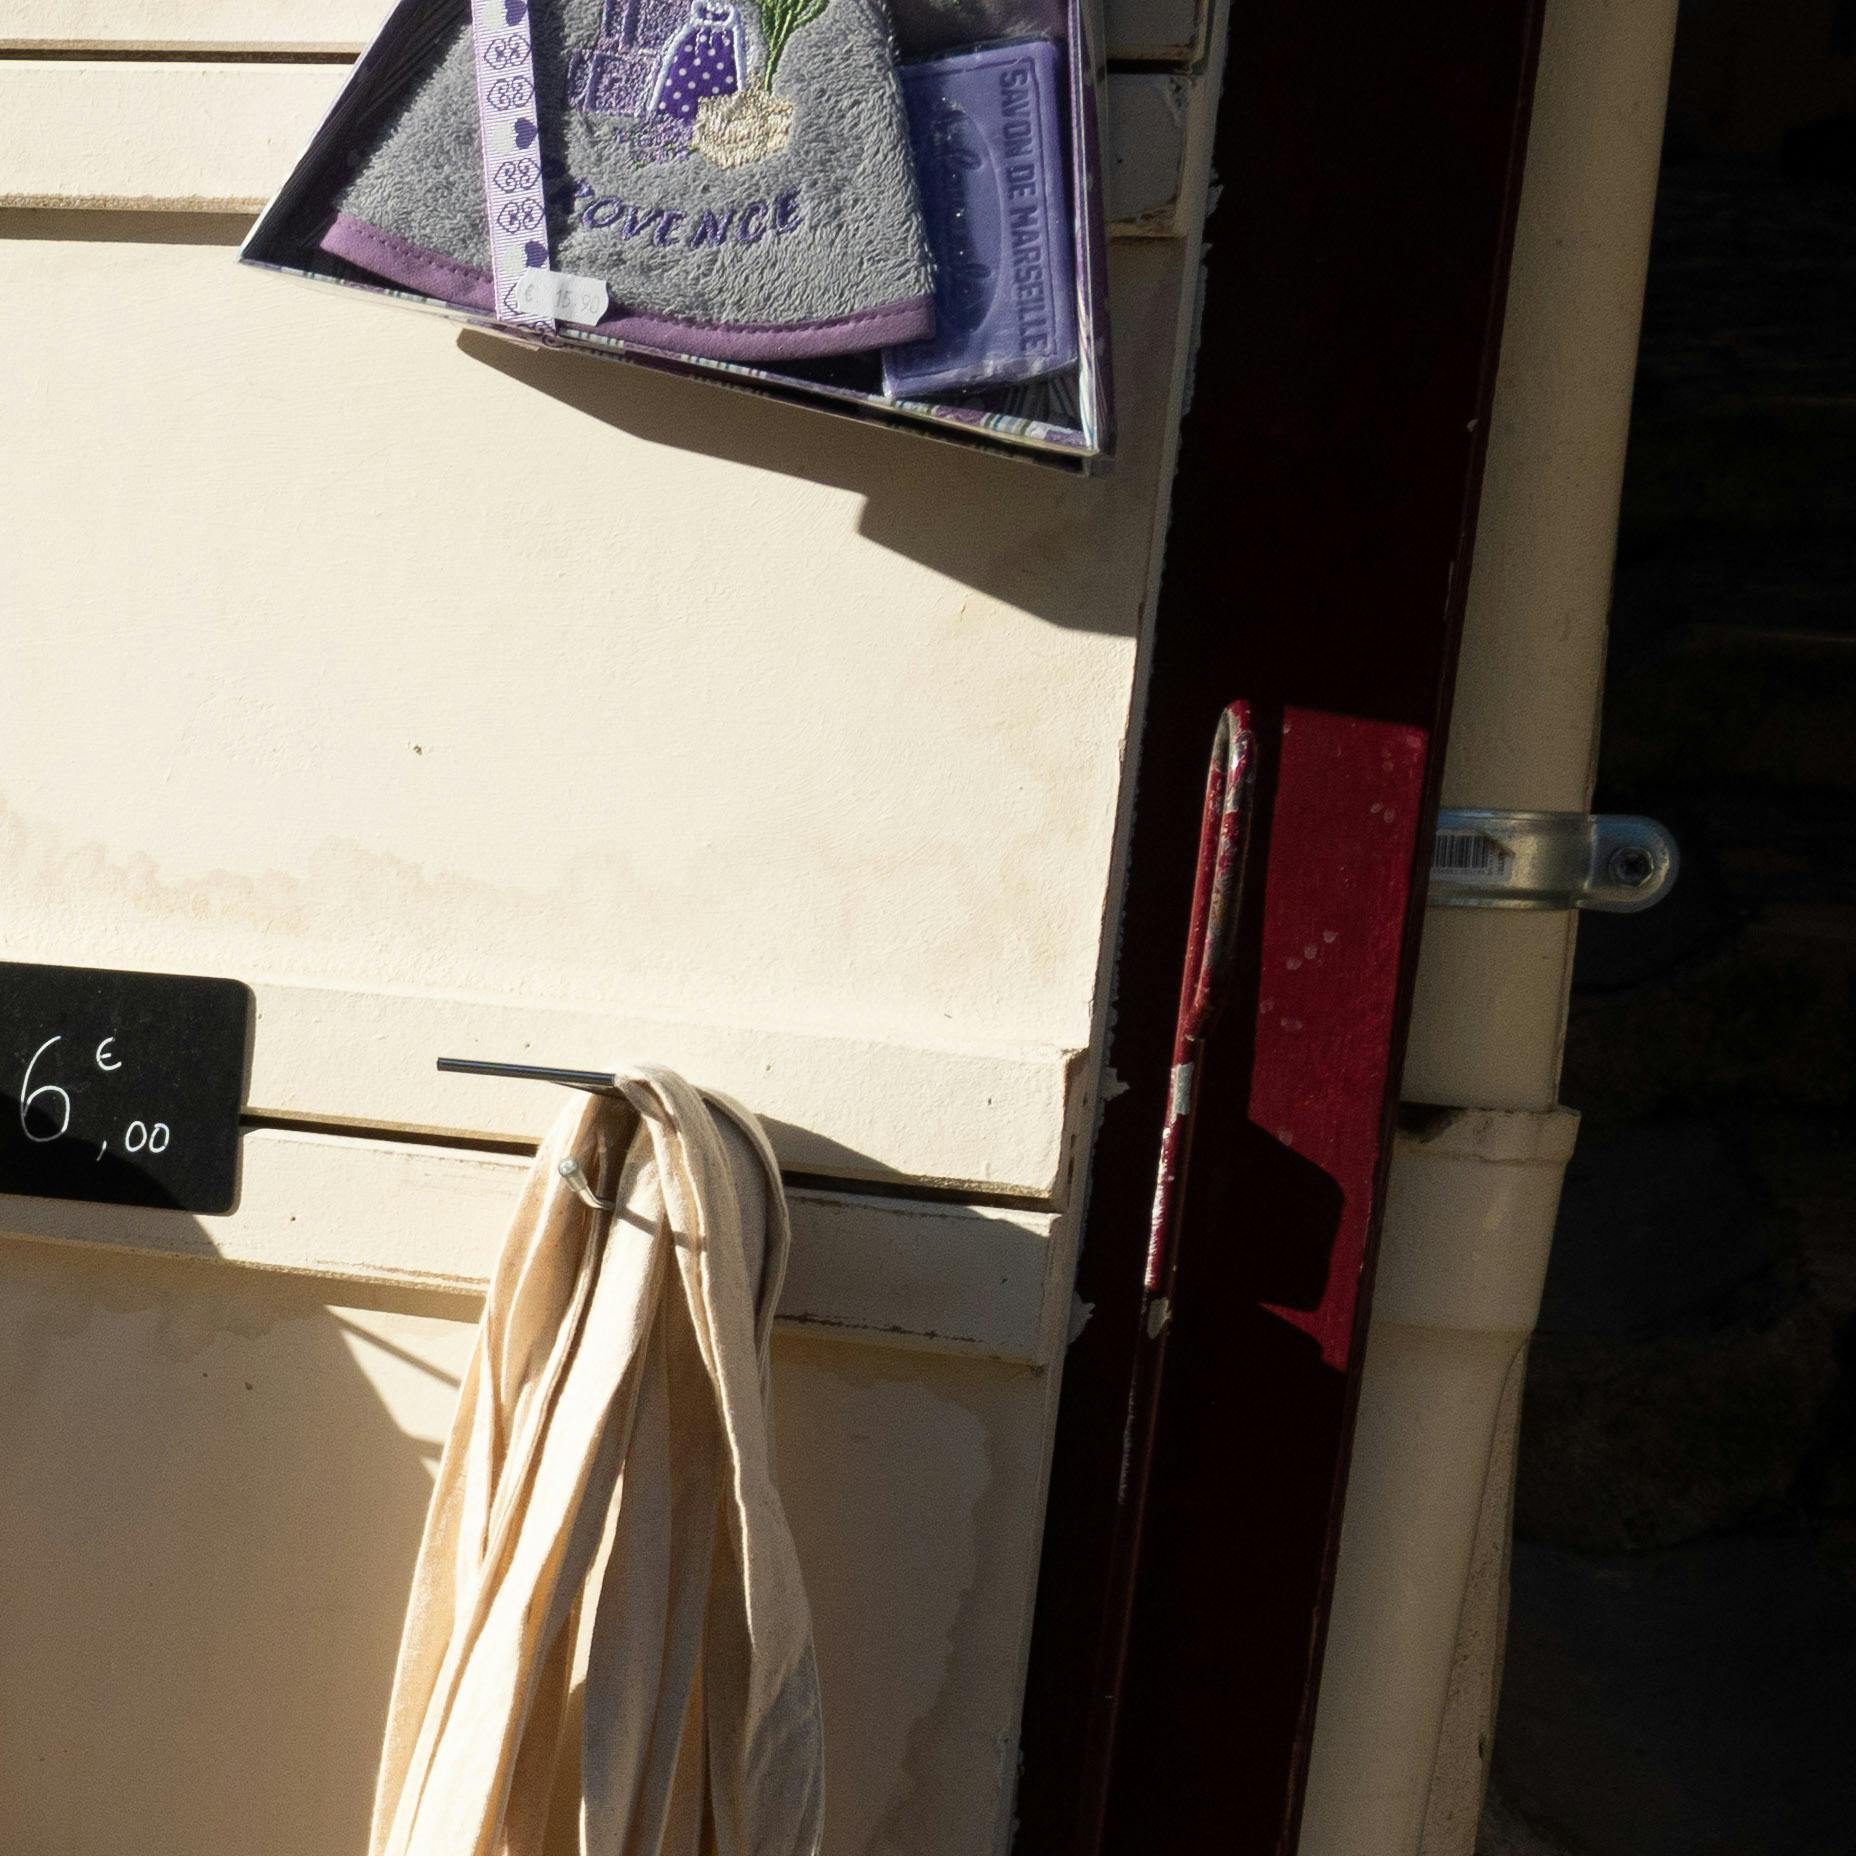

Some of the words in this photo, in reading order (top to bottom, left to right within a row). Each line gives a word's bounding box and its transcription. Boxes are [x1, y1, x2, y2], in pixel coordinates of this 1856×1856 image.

[998, 68, 1034, 158] SAVON
[574, 178, 804, 249] OVENCE
[1004, 164, 1036, 201] DE
[1009, 207, 1049, 354] MARSEILLE
